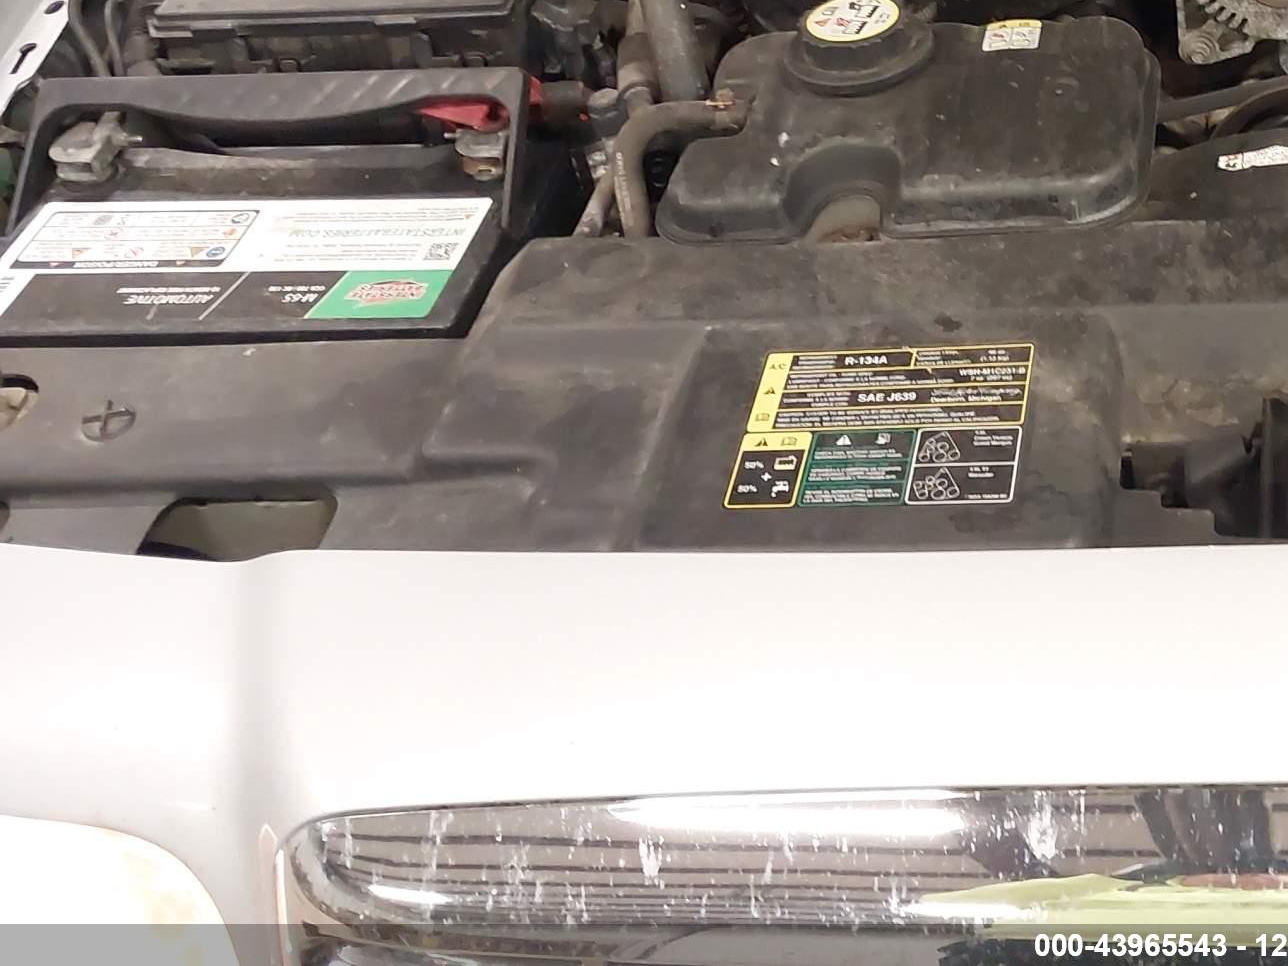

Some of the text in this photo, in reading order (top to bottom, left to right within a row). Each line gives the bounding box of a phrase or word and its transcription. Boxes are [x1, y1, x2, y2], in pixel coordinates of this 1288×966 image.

[124, 294, 214, 304] AUTOMOTIVE
[844, 355, 889, 366] R-134A
[857, 393, 885, 403] SAE
[886, 391, 917, 402] J639
